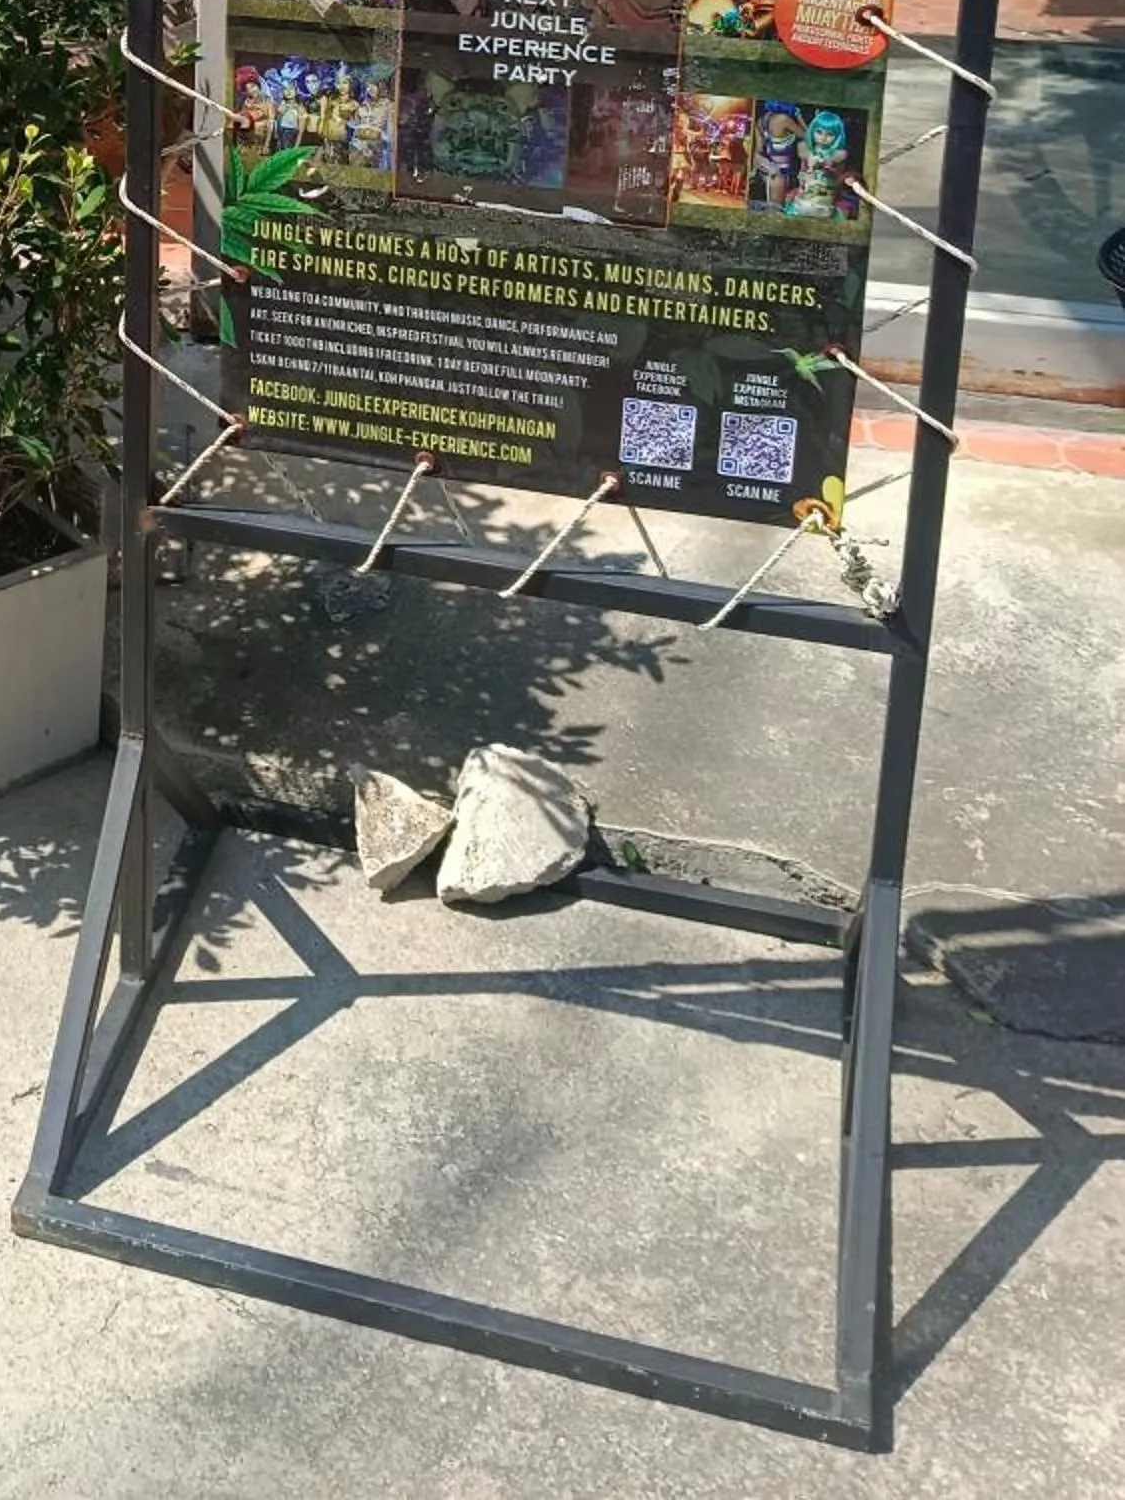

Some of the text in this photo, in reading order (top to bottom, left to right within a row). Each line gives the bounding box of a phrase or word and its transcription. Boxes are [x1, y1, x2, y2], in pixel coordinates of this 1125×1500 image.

[490, 11, 586, 35] JUNGLE
[458, 33, 616, 65] EXPERIENCE
[493, 63, 578, 87] PARTY
[251, 219, 314, 245] JUNGLE
[320, 228, 415, 258] WELCOMES
[420, 241, 431, 259] A
[436, 243, 483, 266] HOST
[488, 249, 508, 268] OF
[251, 248, 288, 270] FIRE
[388, 265, 452, 291] CIRCUS
[457, 273, 577, 307] PERFORMERS
[583, 291, 620, 314] AND
[521, 321, 595, 343] PERFORMANCE
[597, 331, 618, 346] AND
[250, 377, 321, 404] FACEBOOK:
[633, 370, 688, 387] EXPERIENCE
[636, 382, 681, 397] FACEBOOK
[733, 383, 788, 399] EXPERIENCE
[247, 405, 532, 465] WEBSITE: WWW.JUNGLE-EXPERIENCE.COM
[628, 471, 682, 490] SCAN ME
[726, 483, 781, 503] SCAN ME
